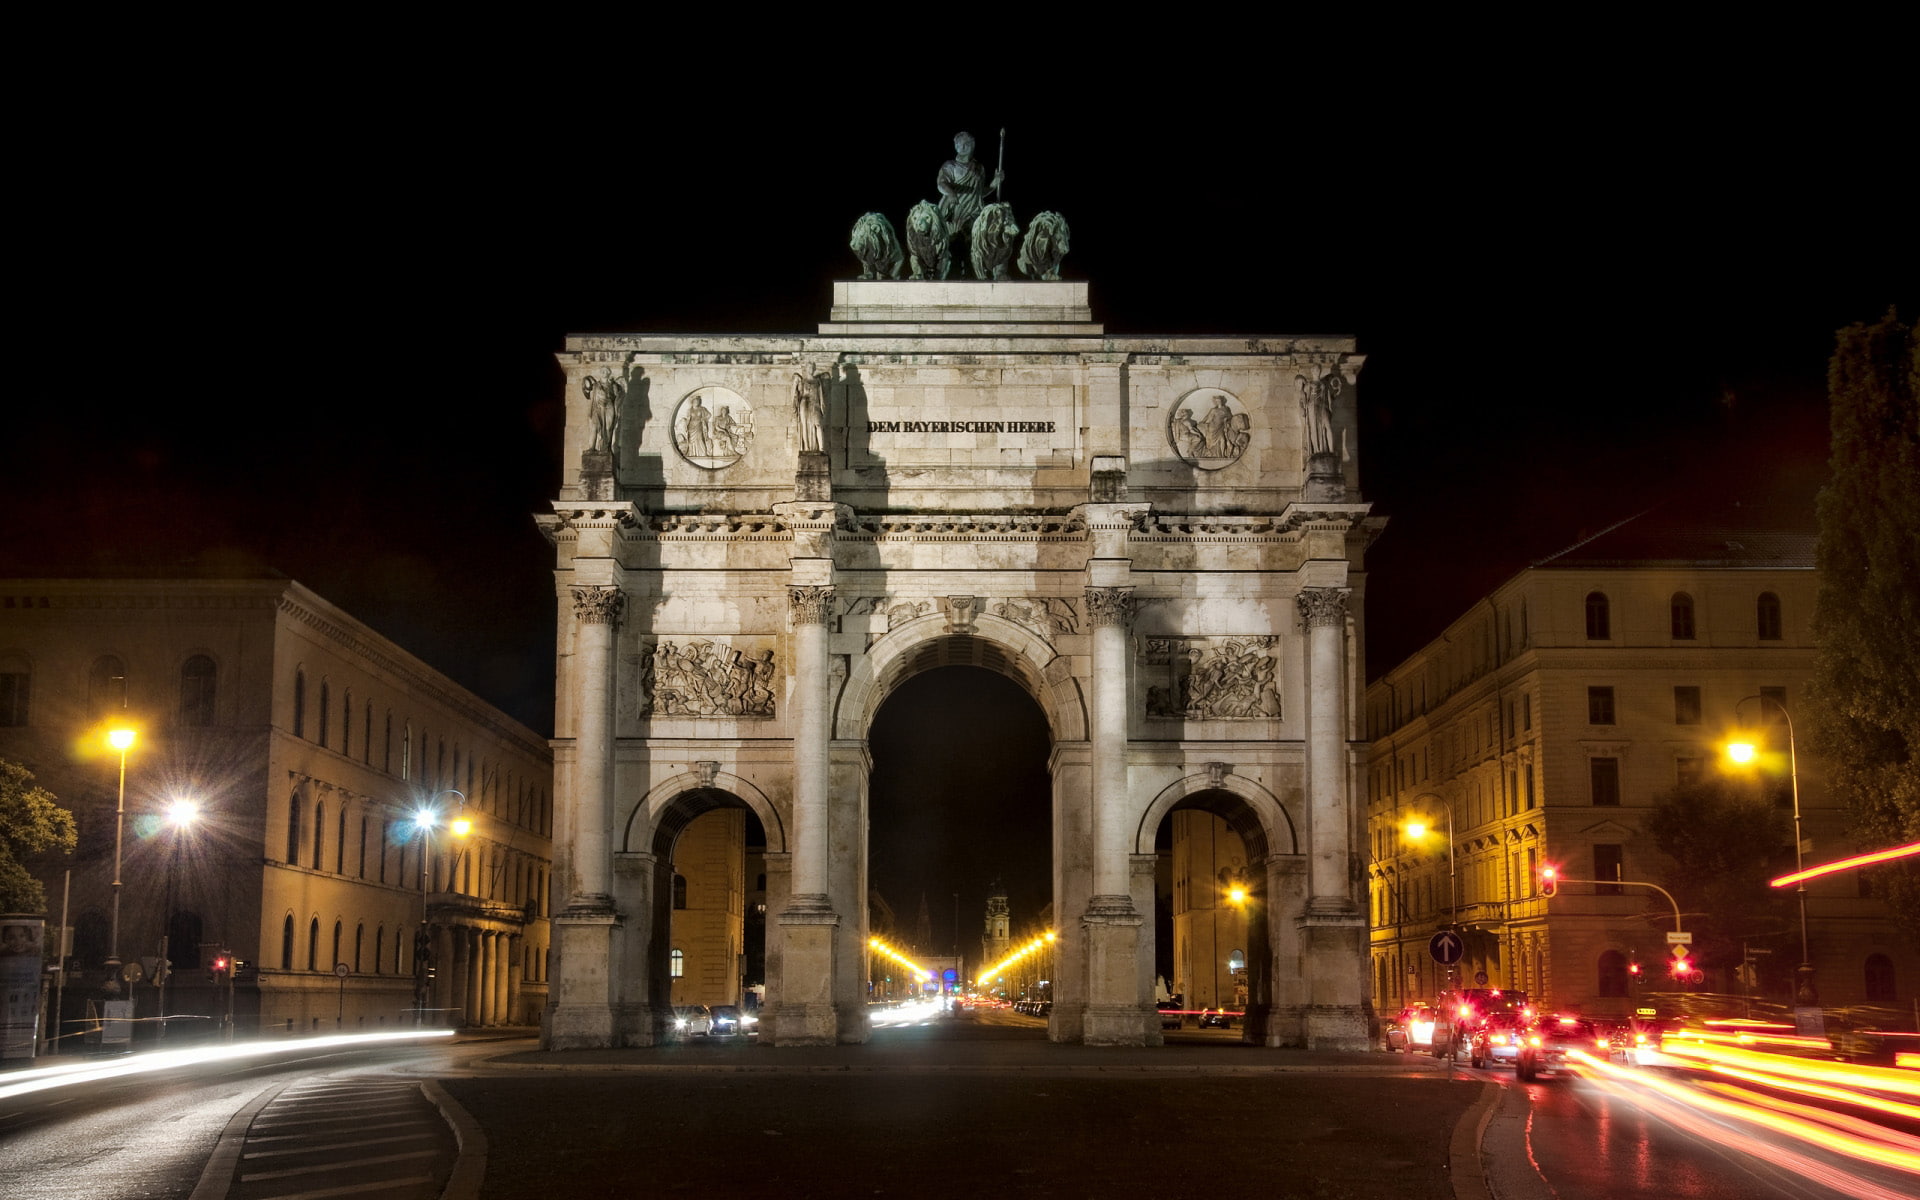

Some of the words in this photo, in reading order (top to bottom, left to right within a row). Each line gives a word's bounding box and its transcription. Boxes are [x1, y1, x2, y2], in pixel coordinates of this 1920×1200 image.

[867, 421, 900, 433] DEM
[903, 421, 1004, 433] BAYERISCHEN
[1007, 421, 1056, 433] HEERE
